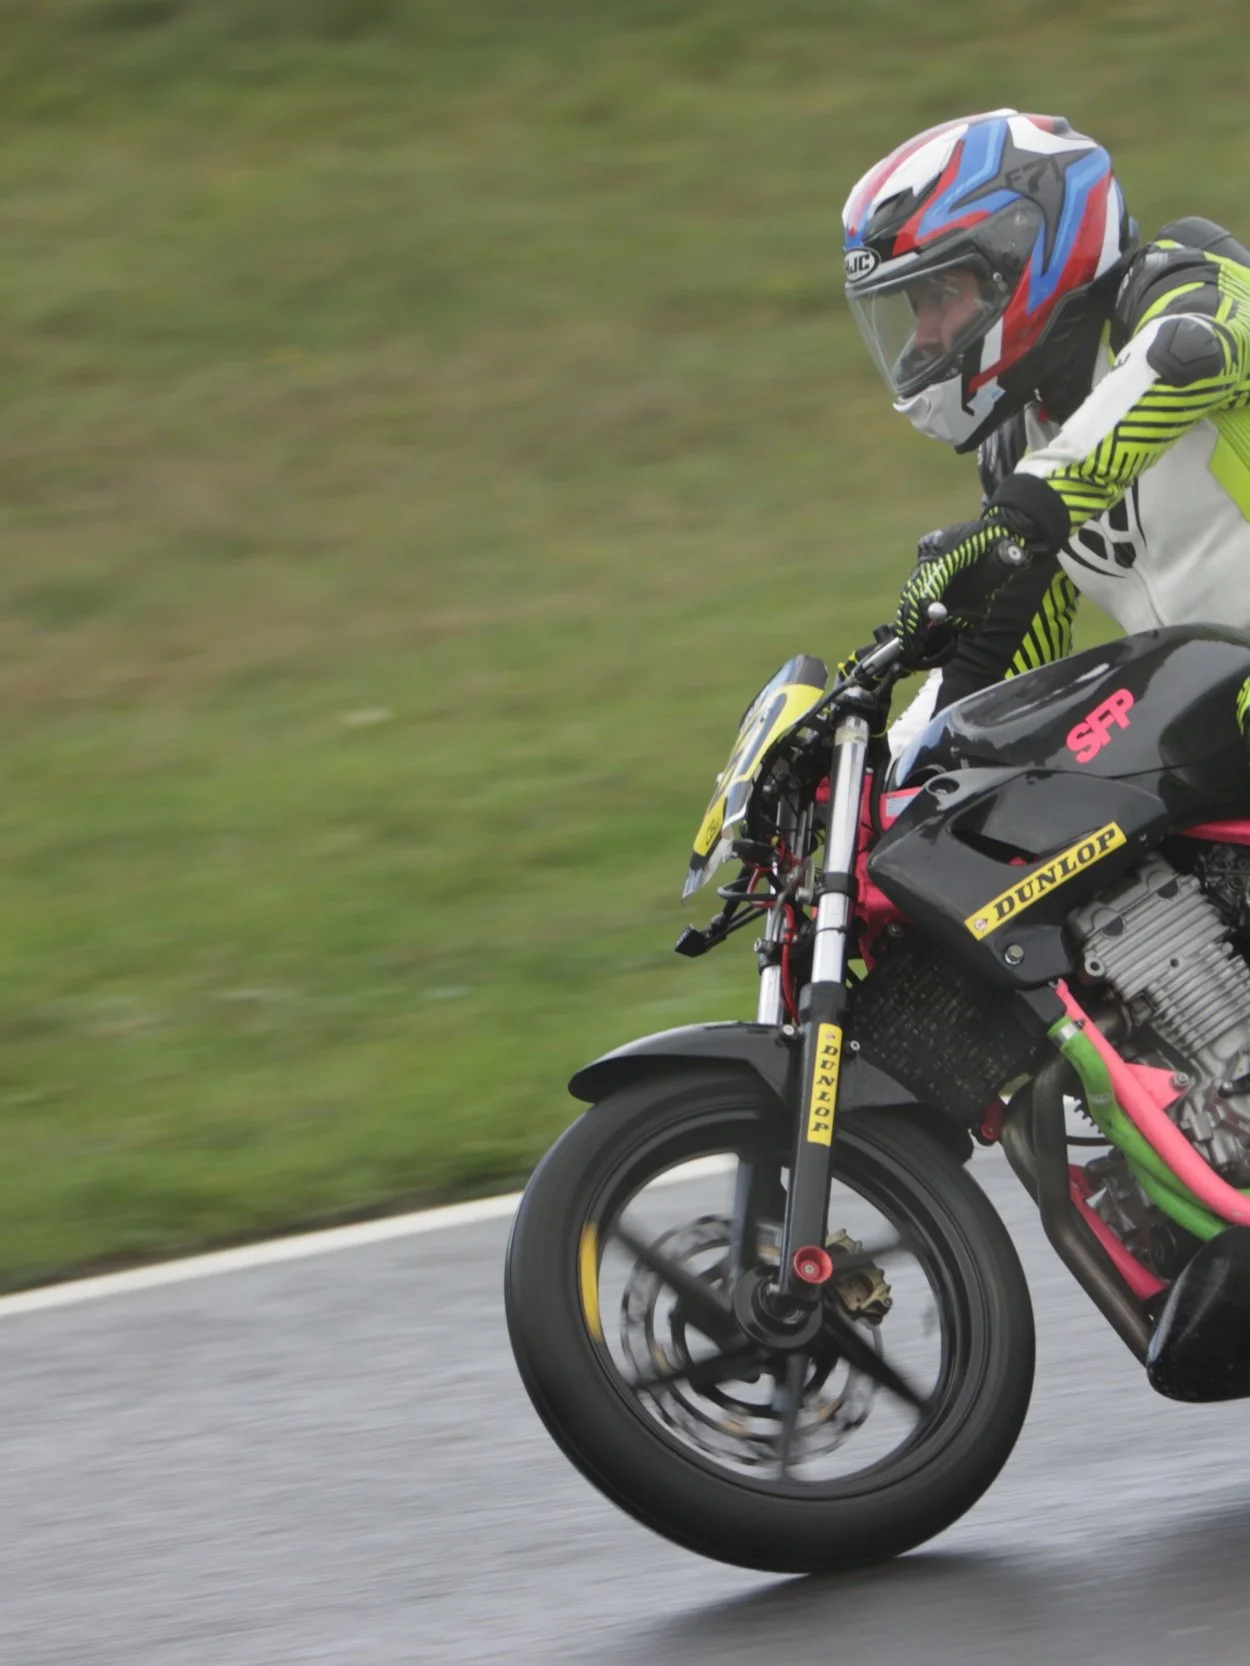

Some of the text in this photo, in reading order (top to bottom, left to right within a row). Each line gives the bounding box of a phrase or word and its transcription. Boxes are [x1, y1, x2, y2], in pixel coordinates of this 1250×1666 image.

[1066, 688, 1136, 764] SFP
[993, 829, 1116, 920] DUNLOP
[812, 1045, 838, 1132] DUNLOP
